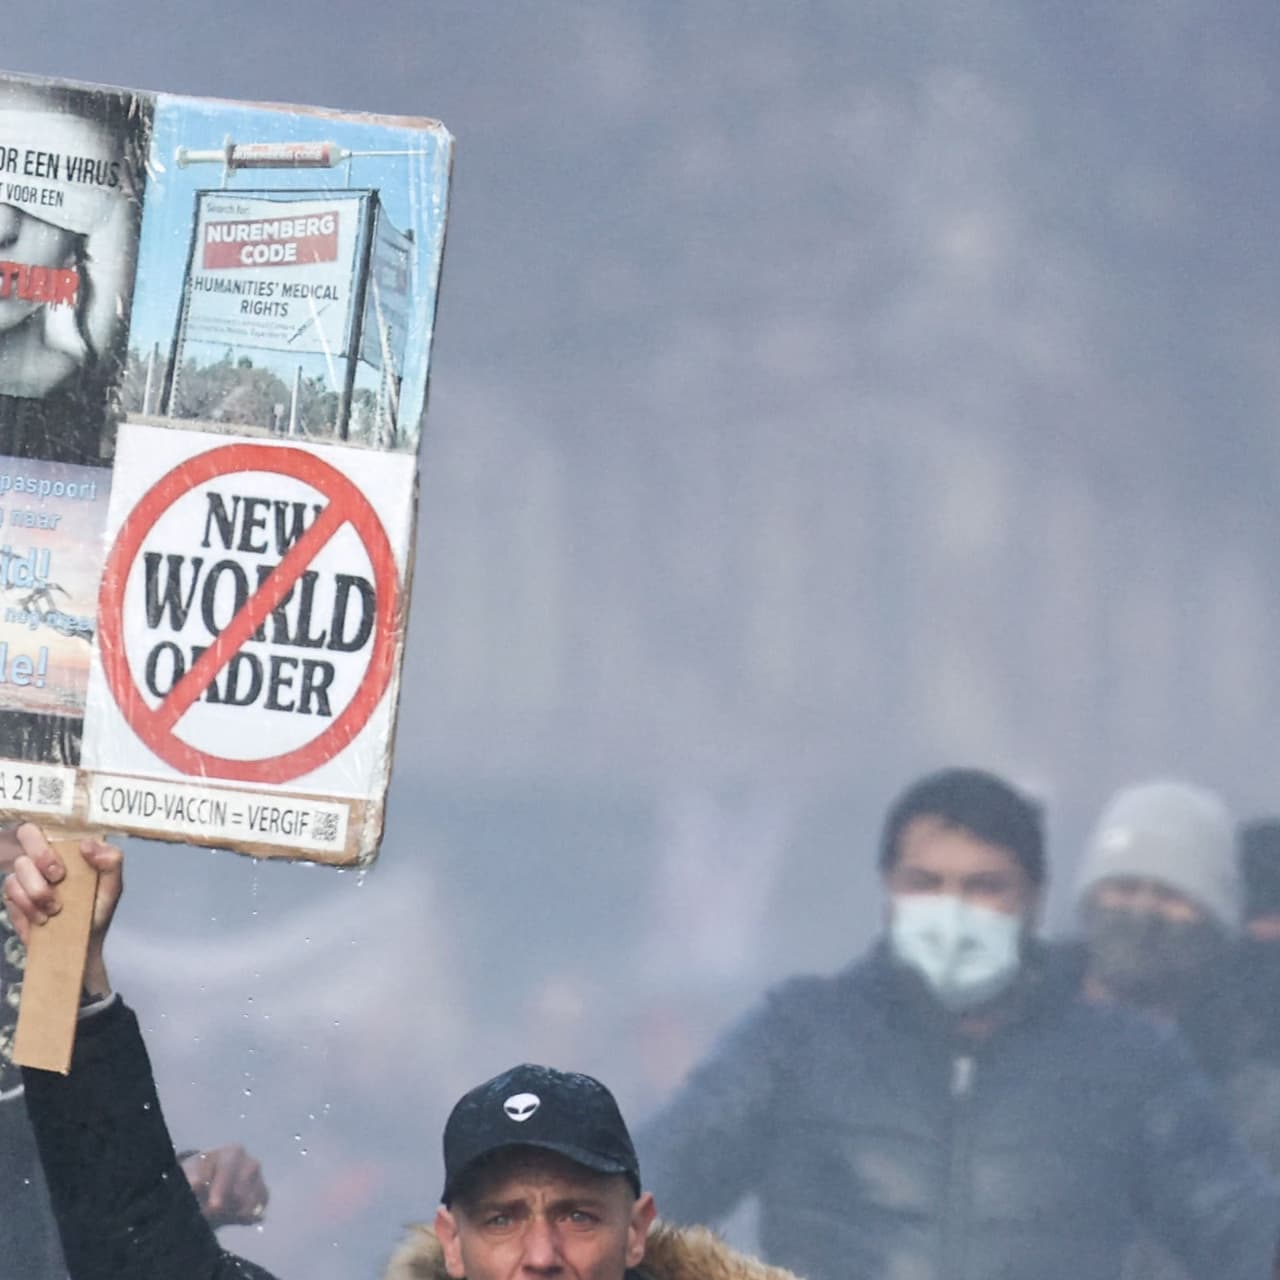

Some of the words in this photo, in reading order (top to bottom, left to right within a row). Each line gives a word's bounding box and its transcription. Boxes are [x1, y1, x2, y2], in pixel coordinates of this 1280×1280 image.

[24, 150, 60, 180] EEN
[6, 186, 38, 203] VOOR
[41, 189, 65, 207] EEN
[207, 215, 335, 243] NUREMBERG
[240, 243, 297, 264] CODE
[282, 283, 339, 301] MEDICAL
[240, 300, 289, 317] RIGHTS
[11, 511, 62, 531] naar
[201, 491, 325, 557] NEW
[12, 774, 34, 802] 21
[99, 786, 227, 826] COVID-VACCIN
[247, 804, 310, 836] VERGIF
